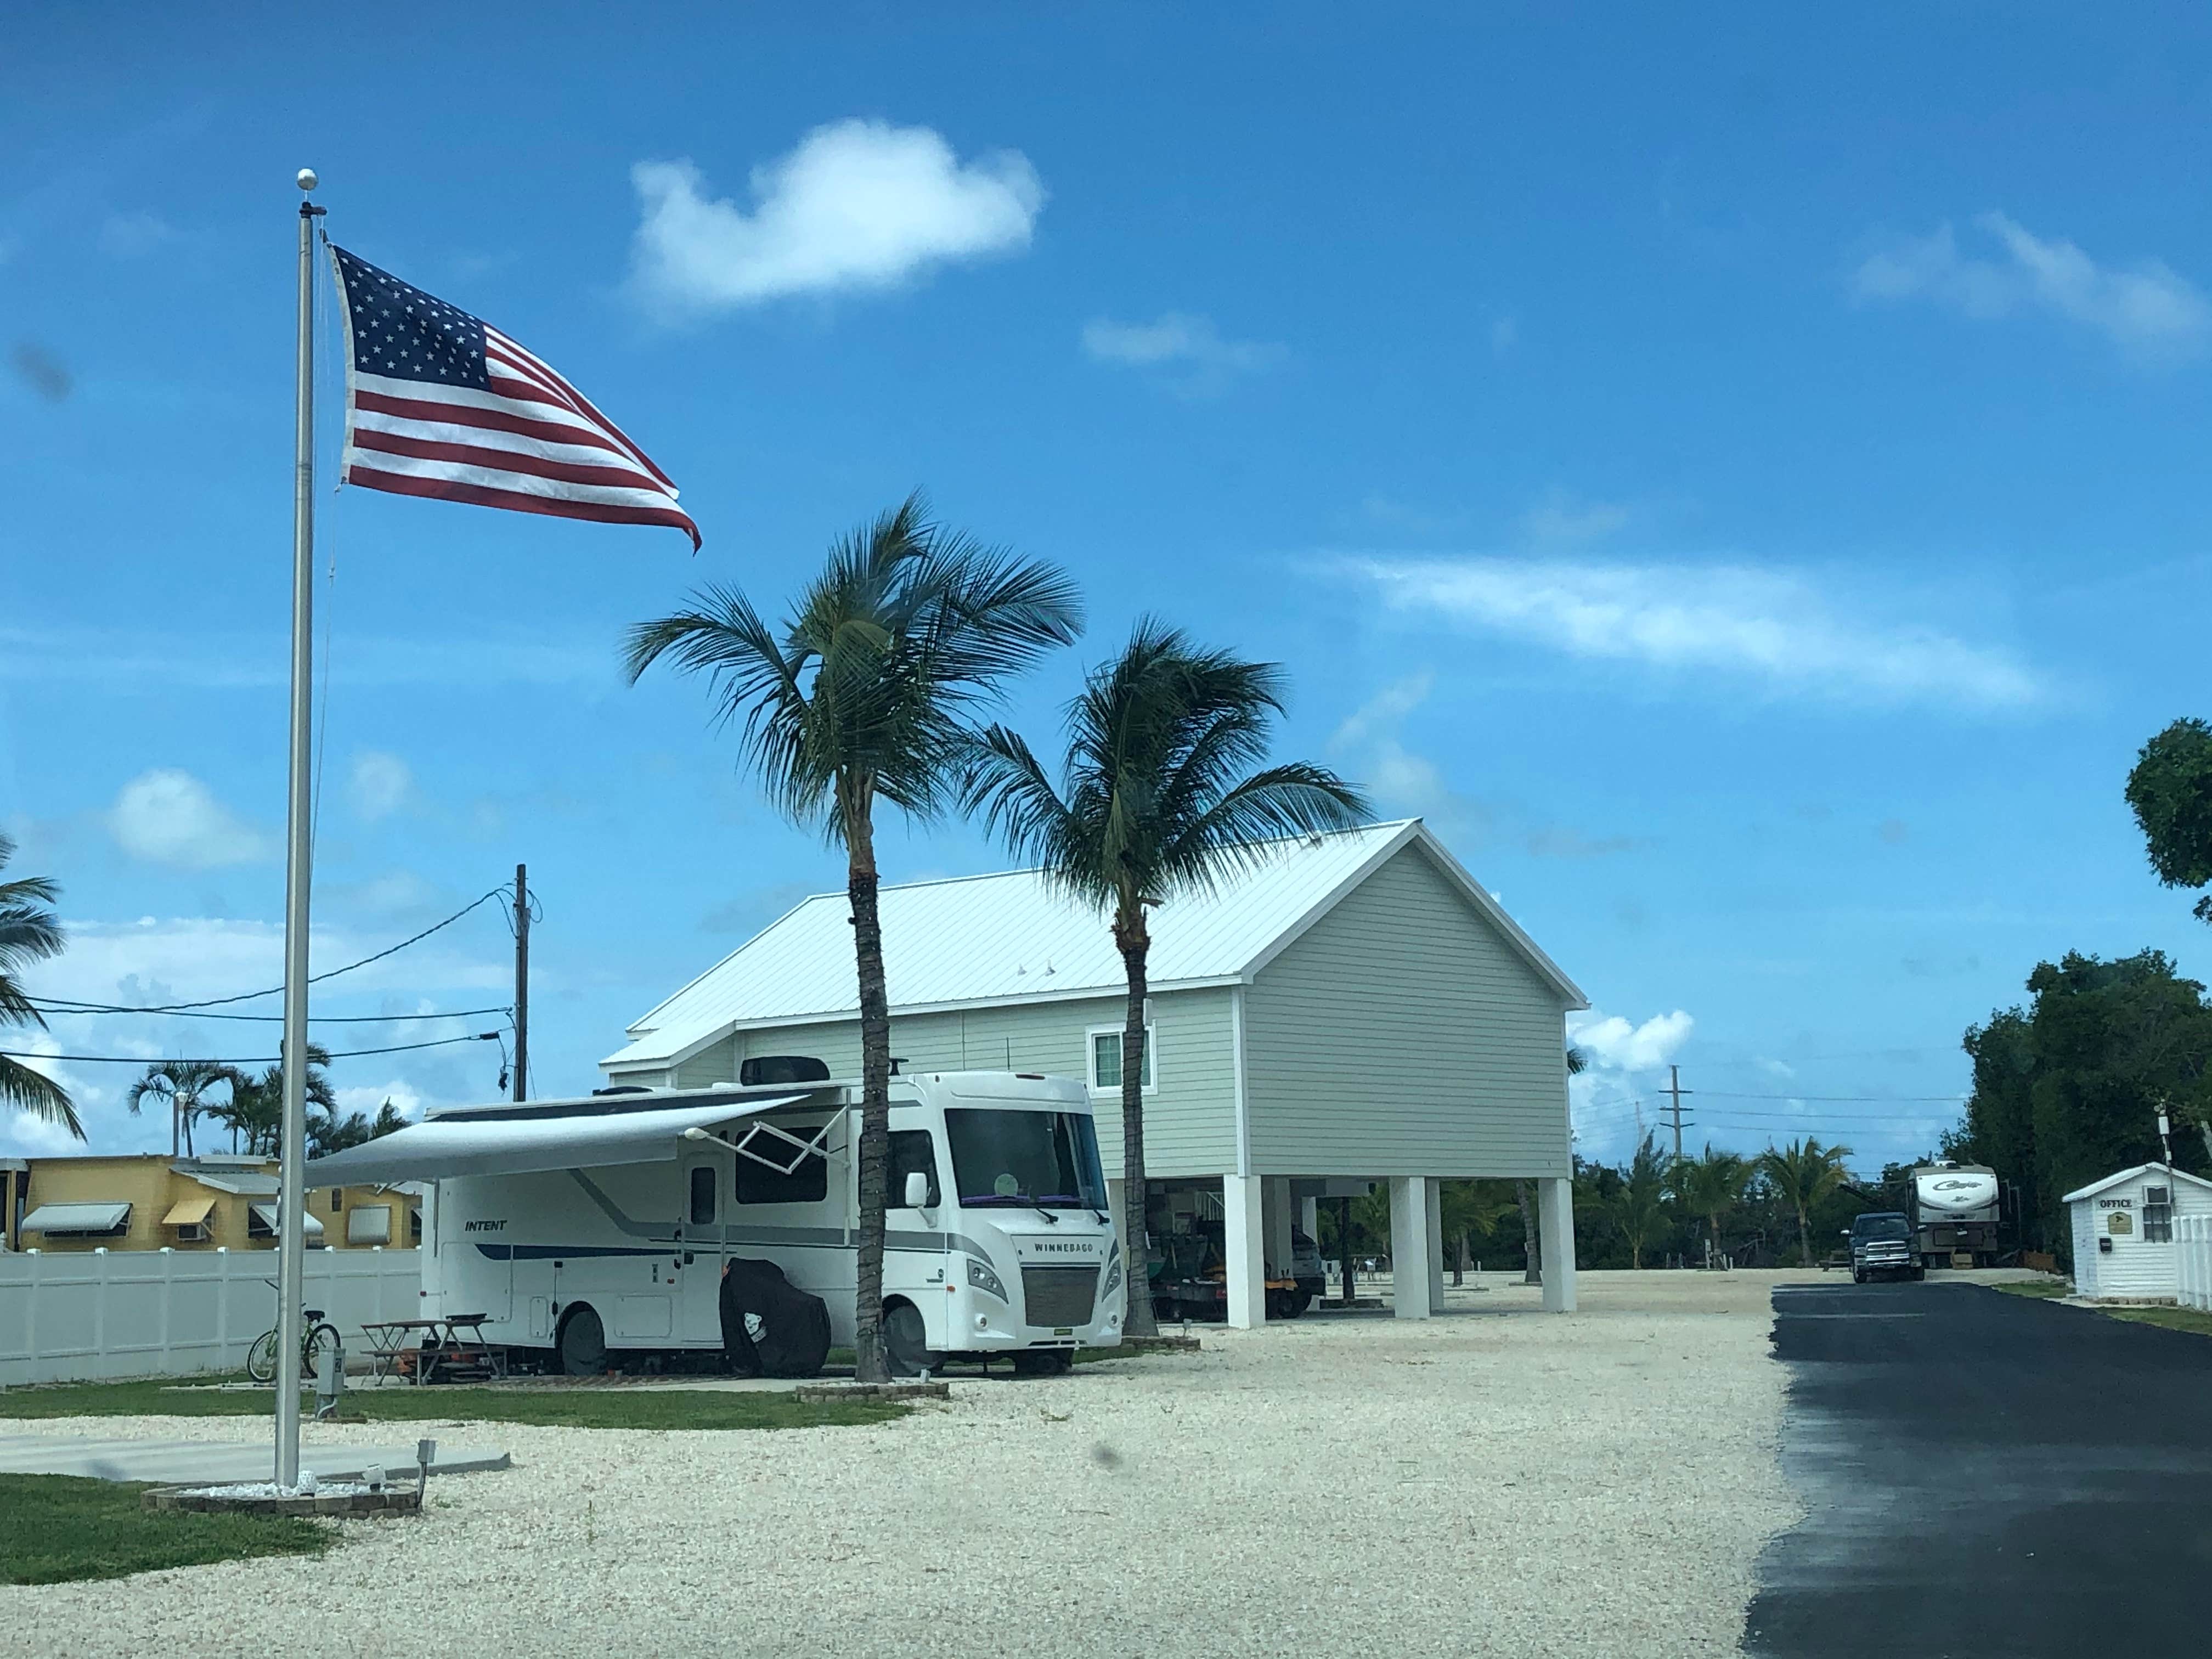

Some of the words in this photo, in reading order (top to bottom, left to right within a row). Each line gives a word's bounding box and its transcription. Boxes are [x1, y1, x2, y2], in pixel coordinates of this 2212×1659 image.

[2100, 1199, 2132, 1207] OFFICE
[465, 1220, 507, 1232] INTENT
[1035, 1243, 1093, 1252] WINNEBAGO
